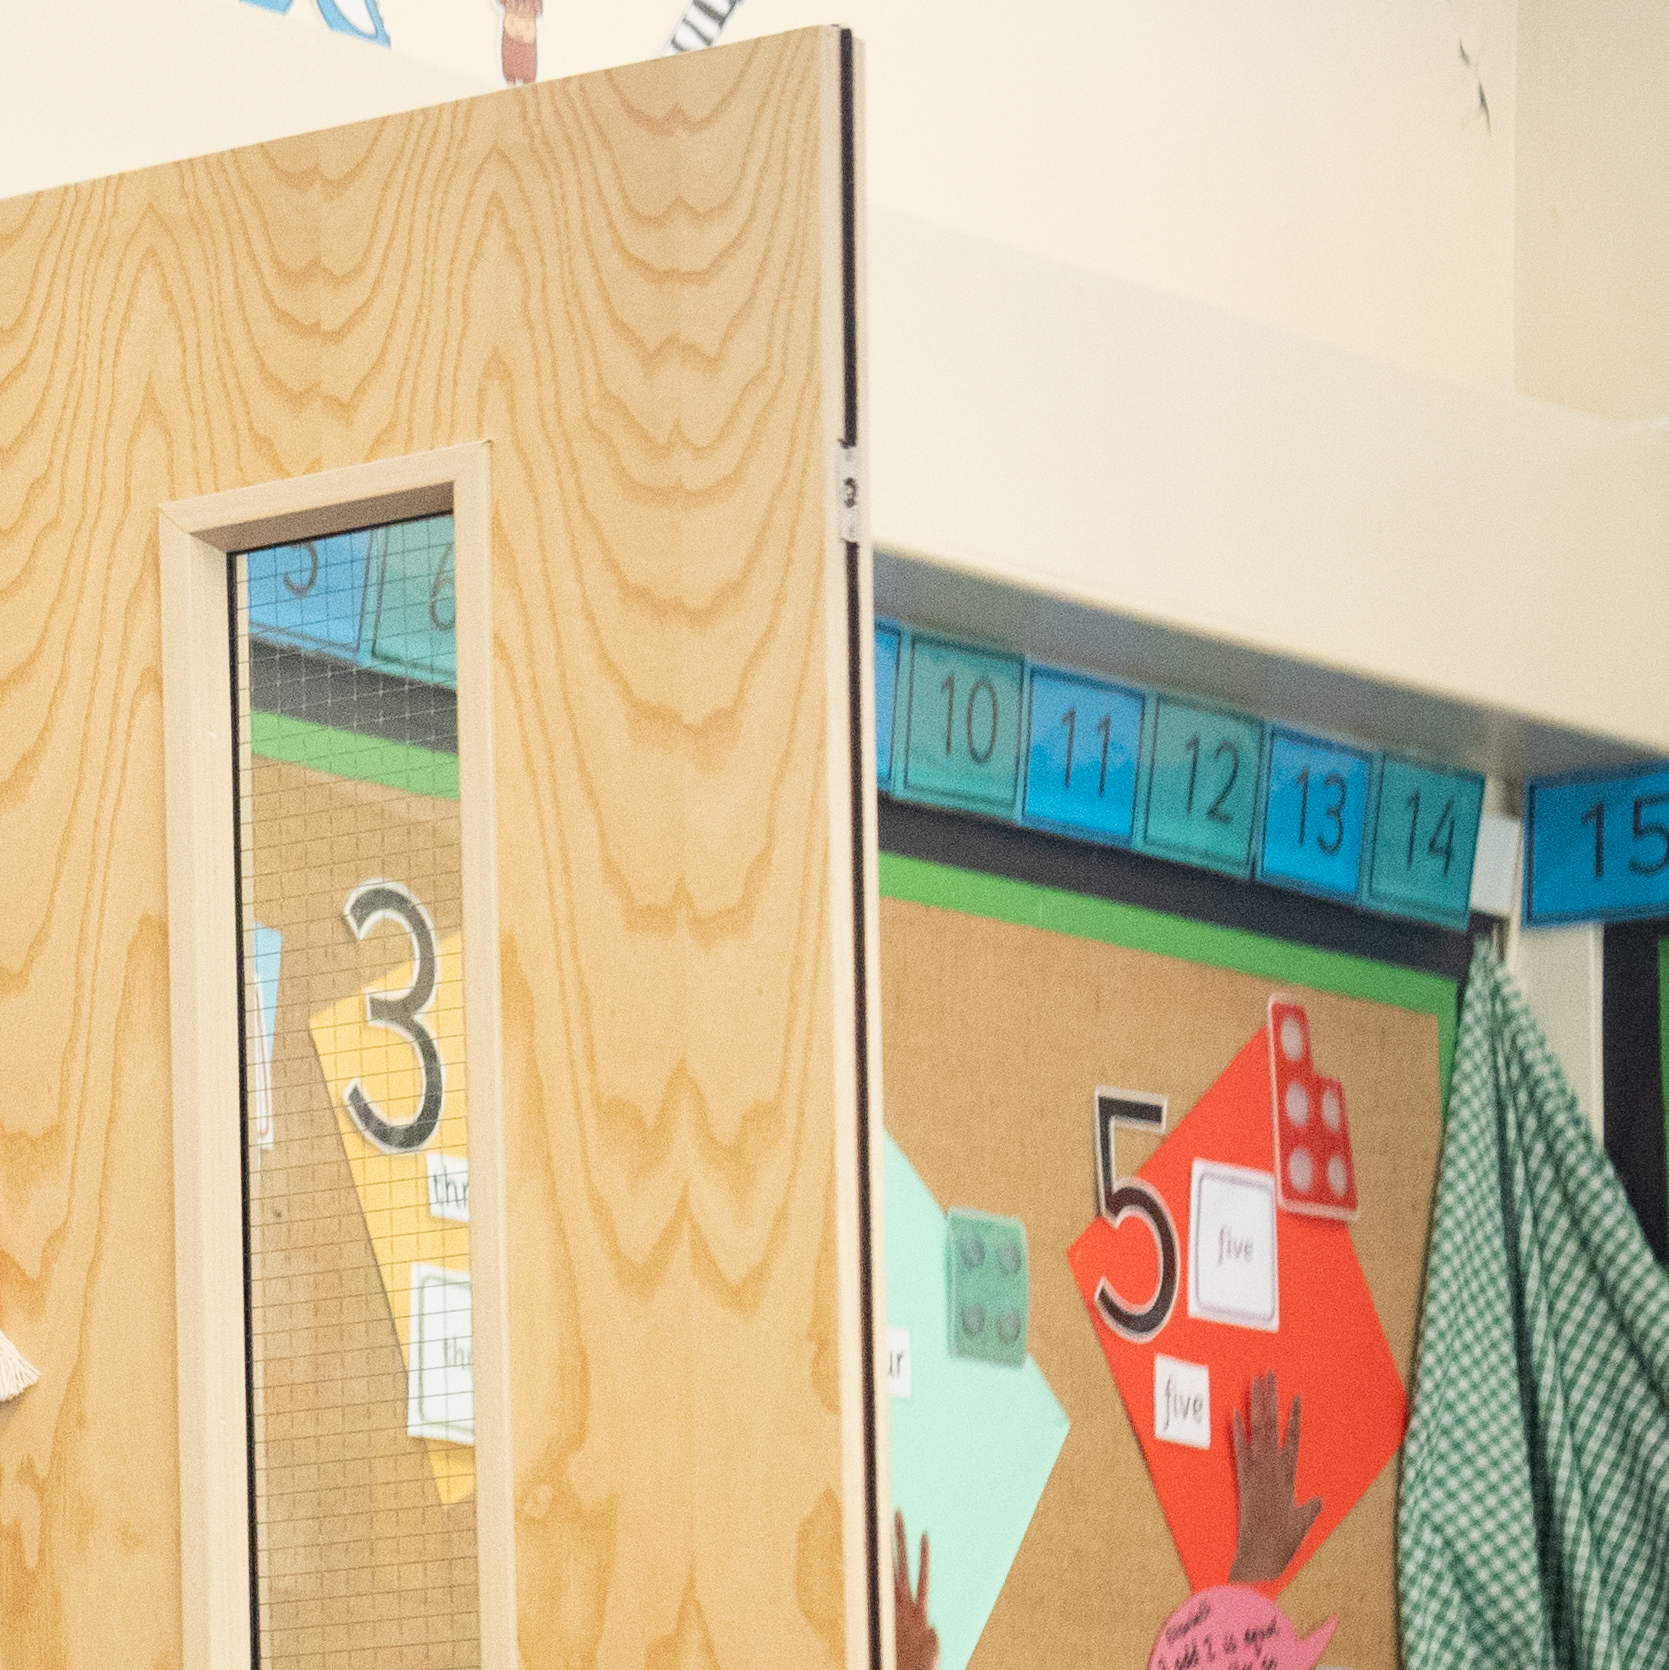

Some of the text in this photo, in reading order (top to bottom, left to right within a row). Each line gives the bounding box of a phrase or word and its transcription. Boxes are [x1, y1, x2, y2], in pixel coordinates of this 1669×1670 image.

[941, 671, 1456, 879] 10 11 12 13 14
[1581, 793, 1668, 880] 15
[345, 881, 445, 1153] 3
[1096, 1089, 1179, 1341] 5
[1218, 1224, 1254, 1267] five
[1163, 1374, 1203, 1432] five
